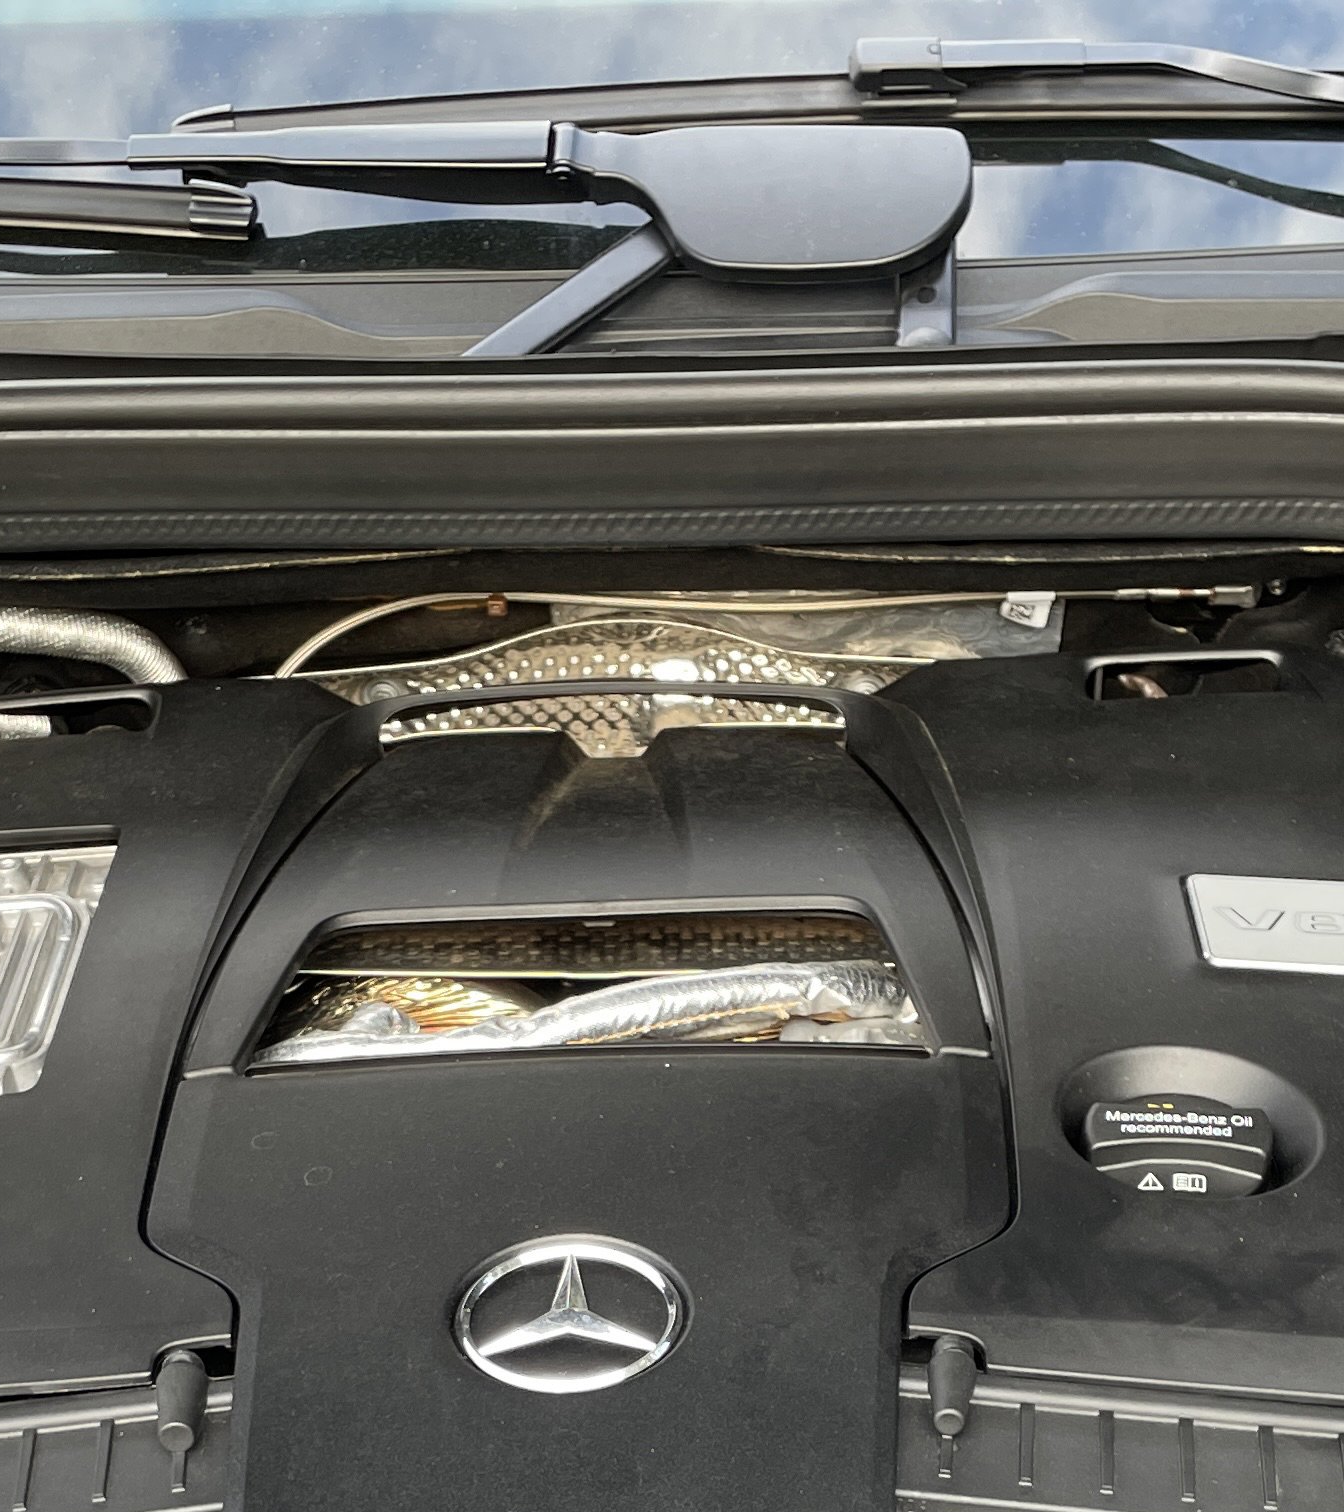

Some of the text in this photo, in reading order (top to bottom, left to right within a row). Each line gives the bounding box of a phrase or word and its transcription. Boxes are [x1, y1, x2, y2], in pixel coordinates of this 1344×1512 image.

[1105, 1110, 1254, 1127] Mercedes-Benz Oil
[1120, 1123, 1233, 1137] recommended
